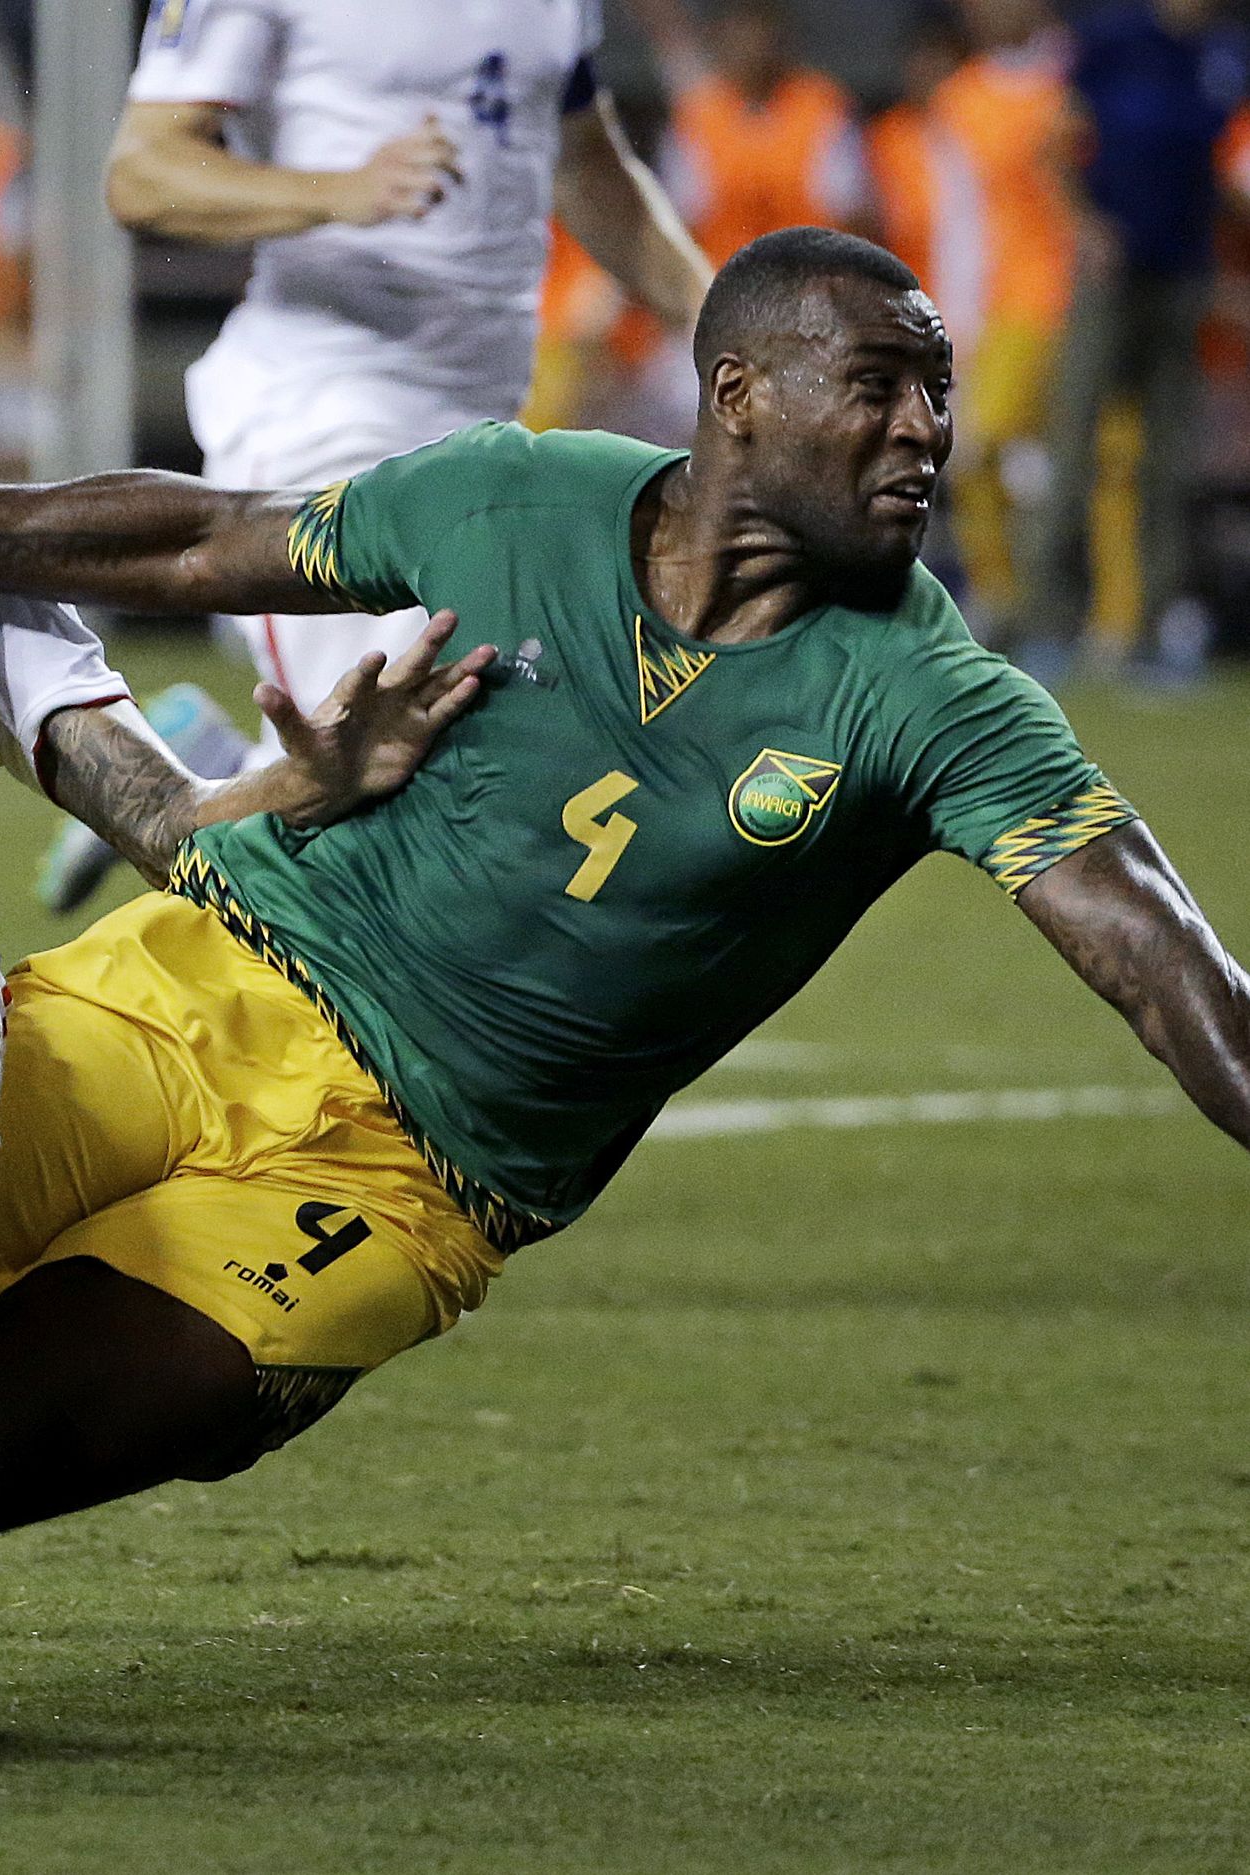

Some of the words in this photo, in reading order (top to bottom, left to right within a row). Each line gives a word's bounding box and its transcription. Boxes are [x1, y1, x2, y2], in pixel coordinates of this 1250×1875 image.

[562, 769, 639, 902] 4
[741, 788, 801, 819] JAMAICA
[295, 1201, 373, 1276] 4
[223, 1260, 300, 1313] romai
